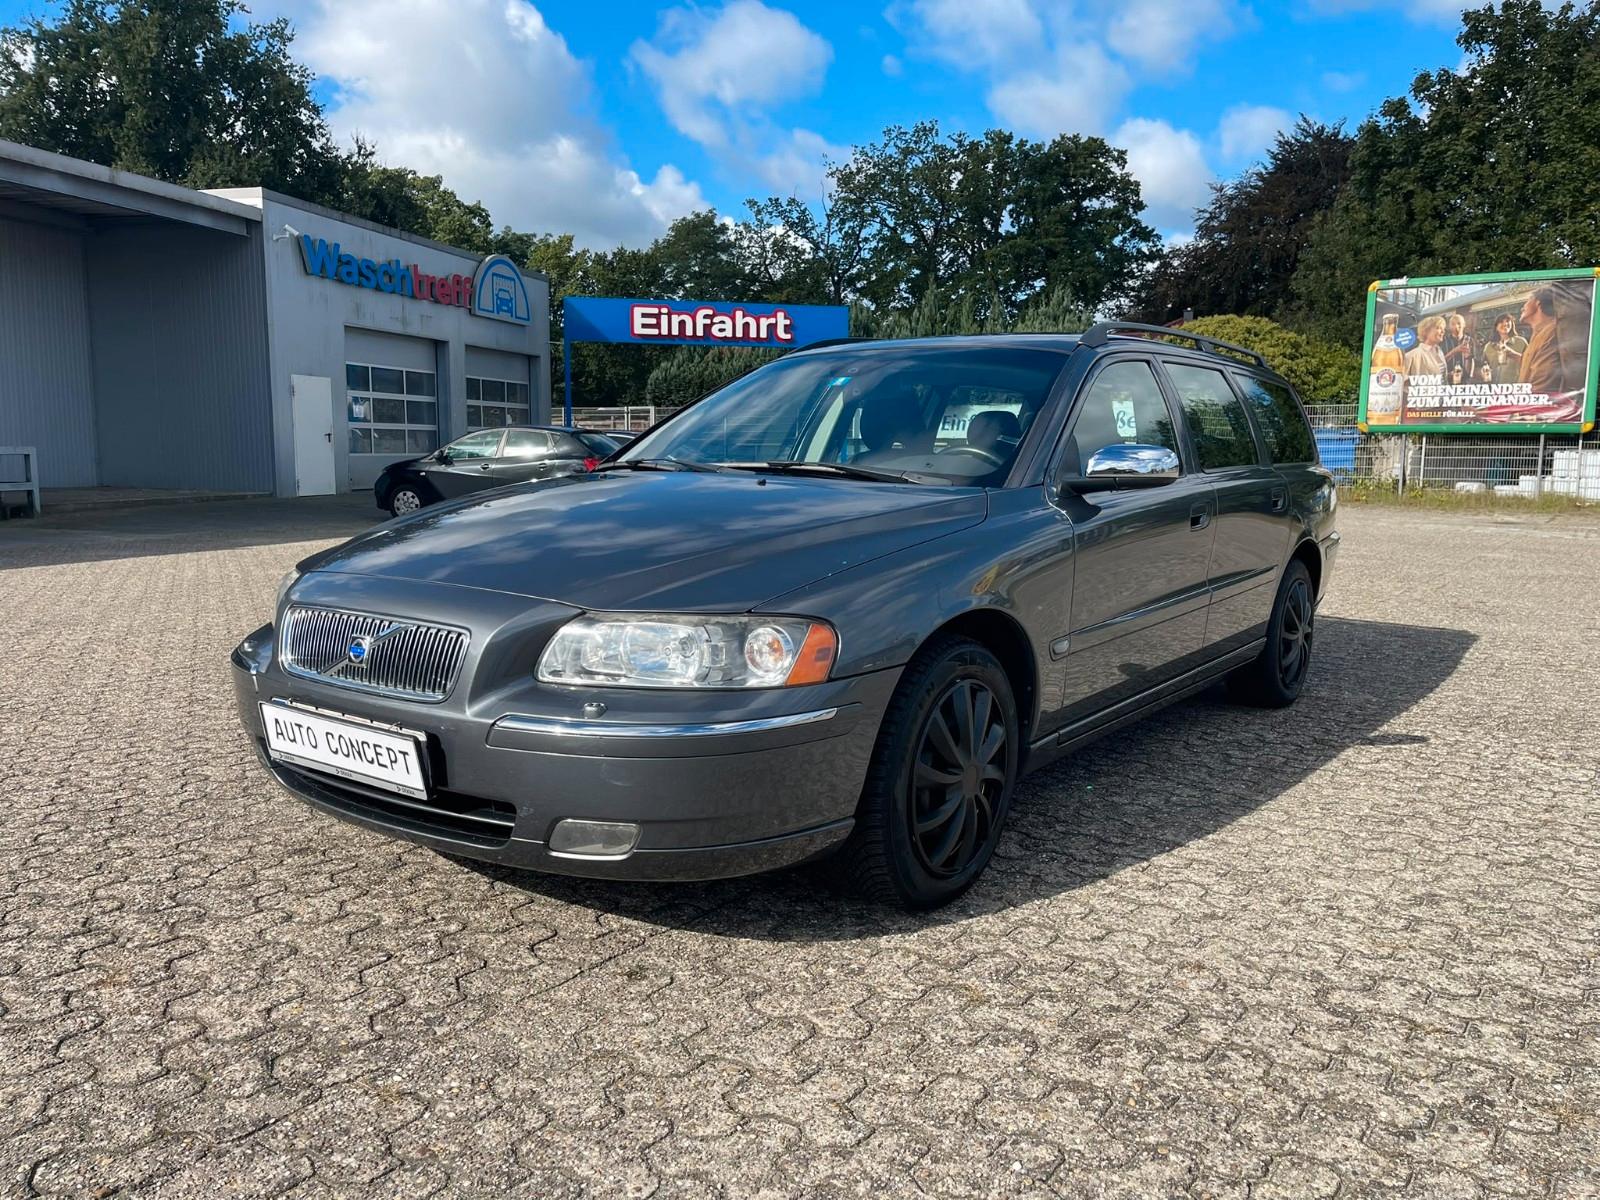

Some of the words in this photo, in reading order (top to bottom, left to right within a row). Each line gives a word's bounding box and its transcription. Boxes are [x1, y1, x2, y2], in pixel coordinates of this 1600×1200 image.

[303, 234, 473, 309] Waschtreff
[633, 306, 793, 340] Einfahrt
[1408, 375, 1442, 386] VOM
[1407, 383, 1533, 397] NEBENEINANDER
[1407, 396, 1440, 408] ZUM
[1443, 394, 1553, 408] MITEINANDER.
[1442, 410, 1457, 418] FÜR
[274, 718, 318, 750] AUTO
[325, 731, 411, 775] CONCEPT
